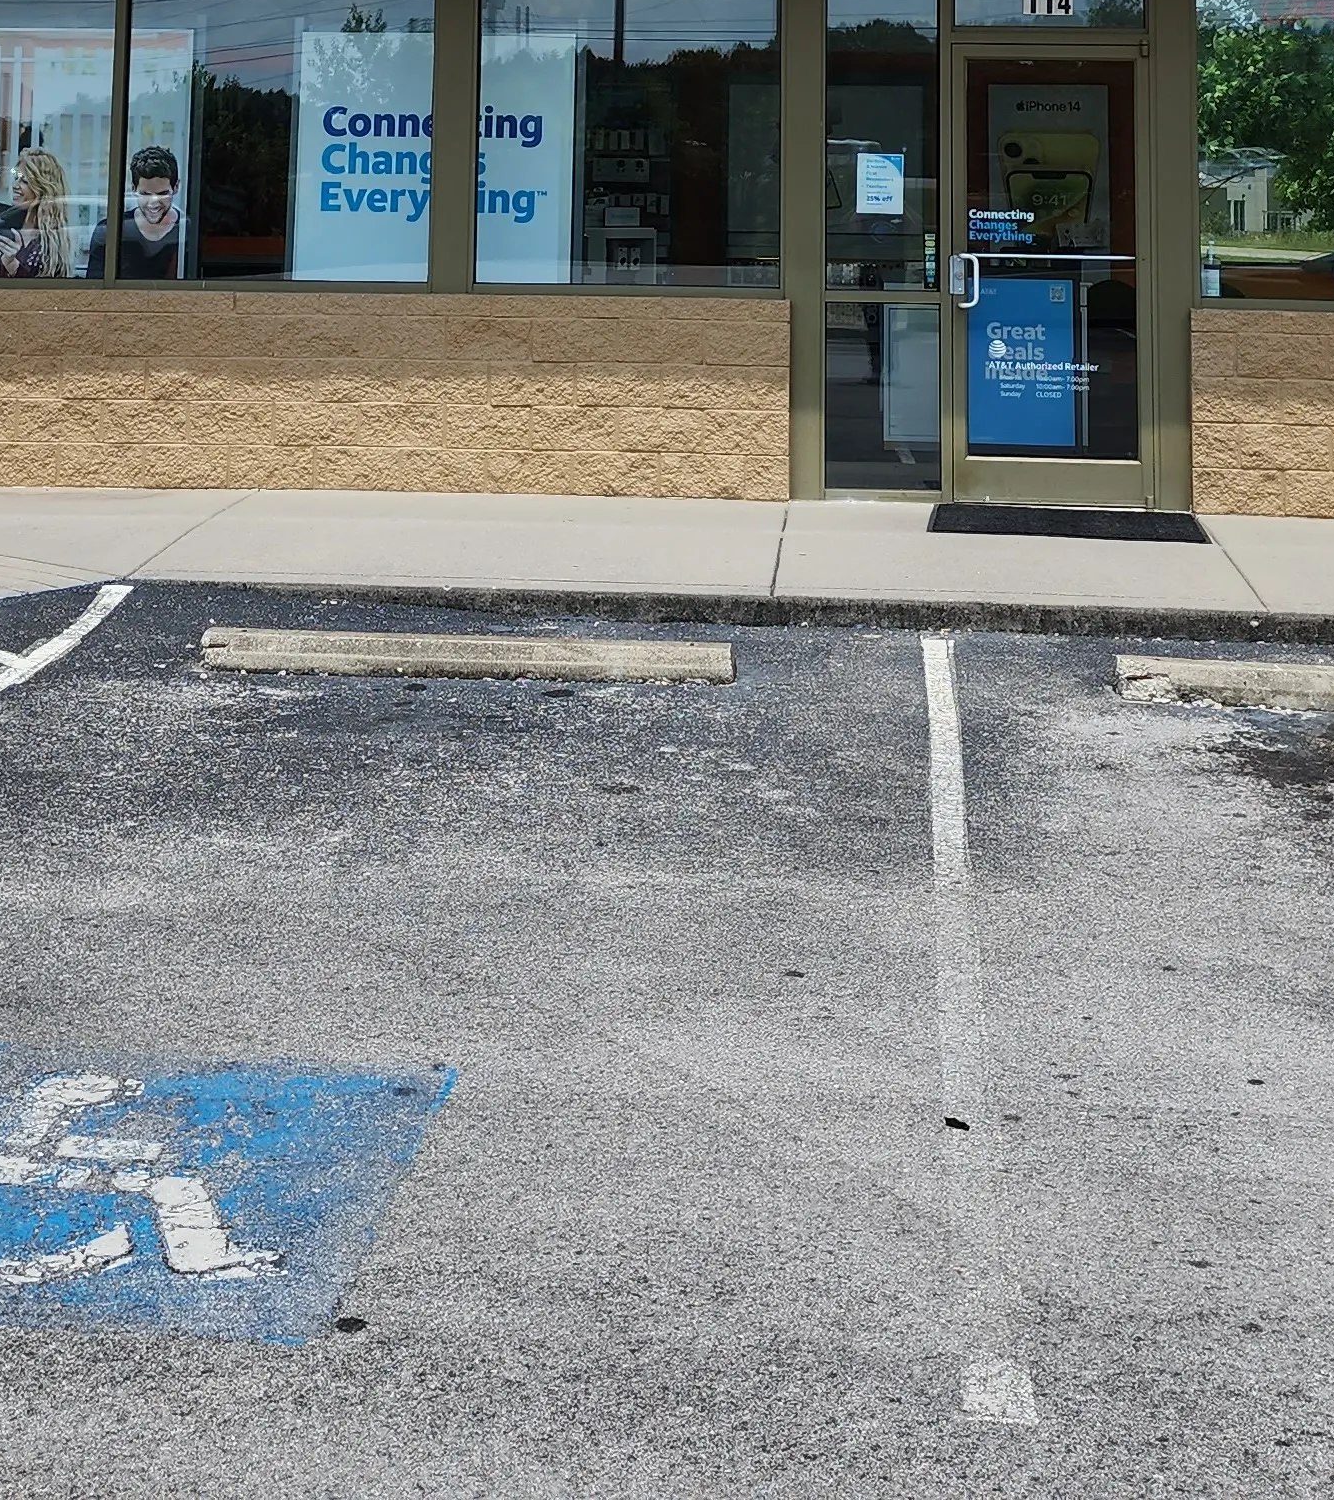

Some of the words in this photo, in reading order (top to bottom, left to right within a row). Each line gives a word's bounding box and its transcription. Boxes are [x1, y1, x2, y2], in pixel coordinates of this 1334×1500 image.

[1026, 100, 1067, 113] iPhone
[1068, 101, 1081, 112] 14
[968, 208, 1035, 222] Connecting
[968, 219, 1018, 231] Changes
[986, 321, 1047, 341] Great
[987, 341, 1045, 361] eals
[988, 360, 1014, 370] AT&T
[1014, 361, 1064, 371] Authorized
[1064, 362, 1100, 372] Retailer
[999, 390, 1022, 398] Sunday
